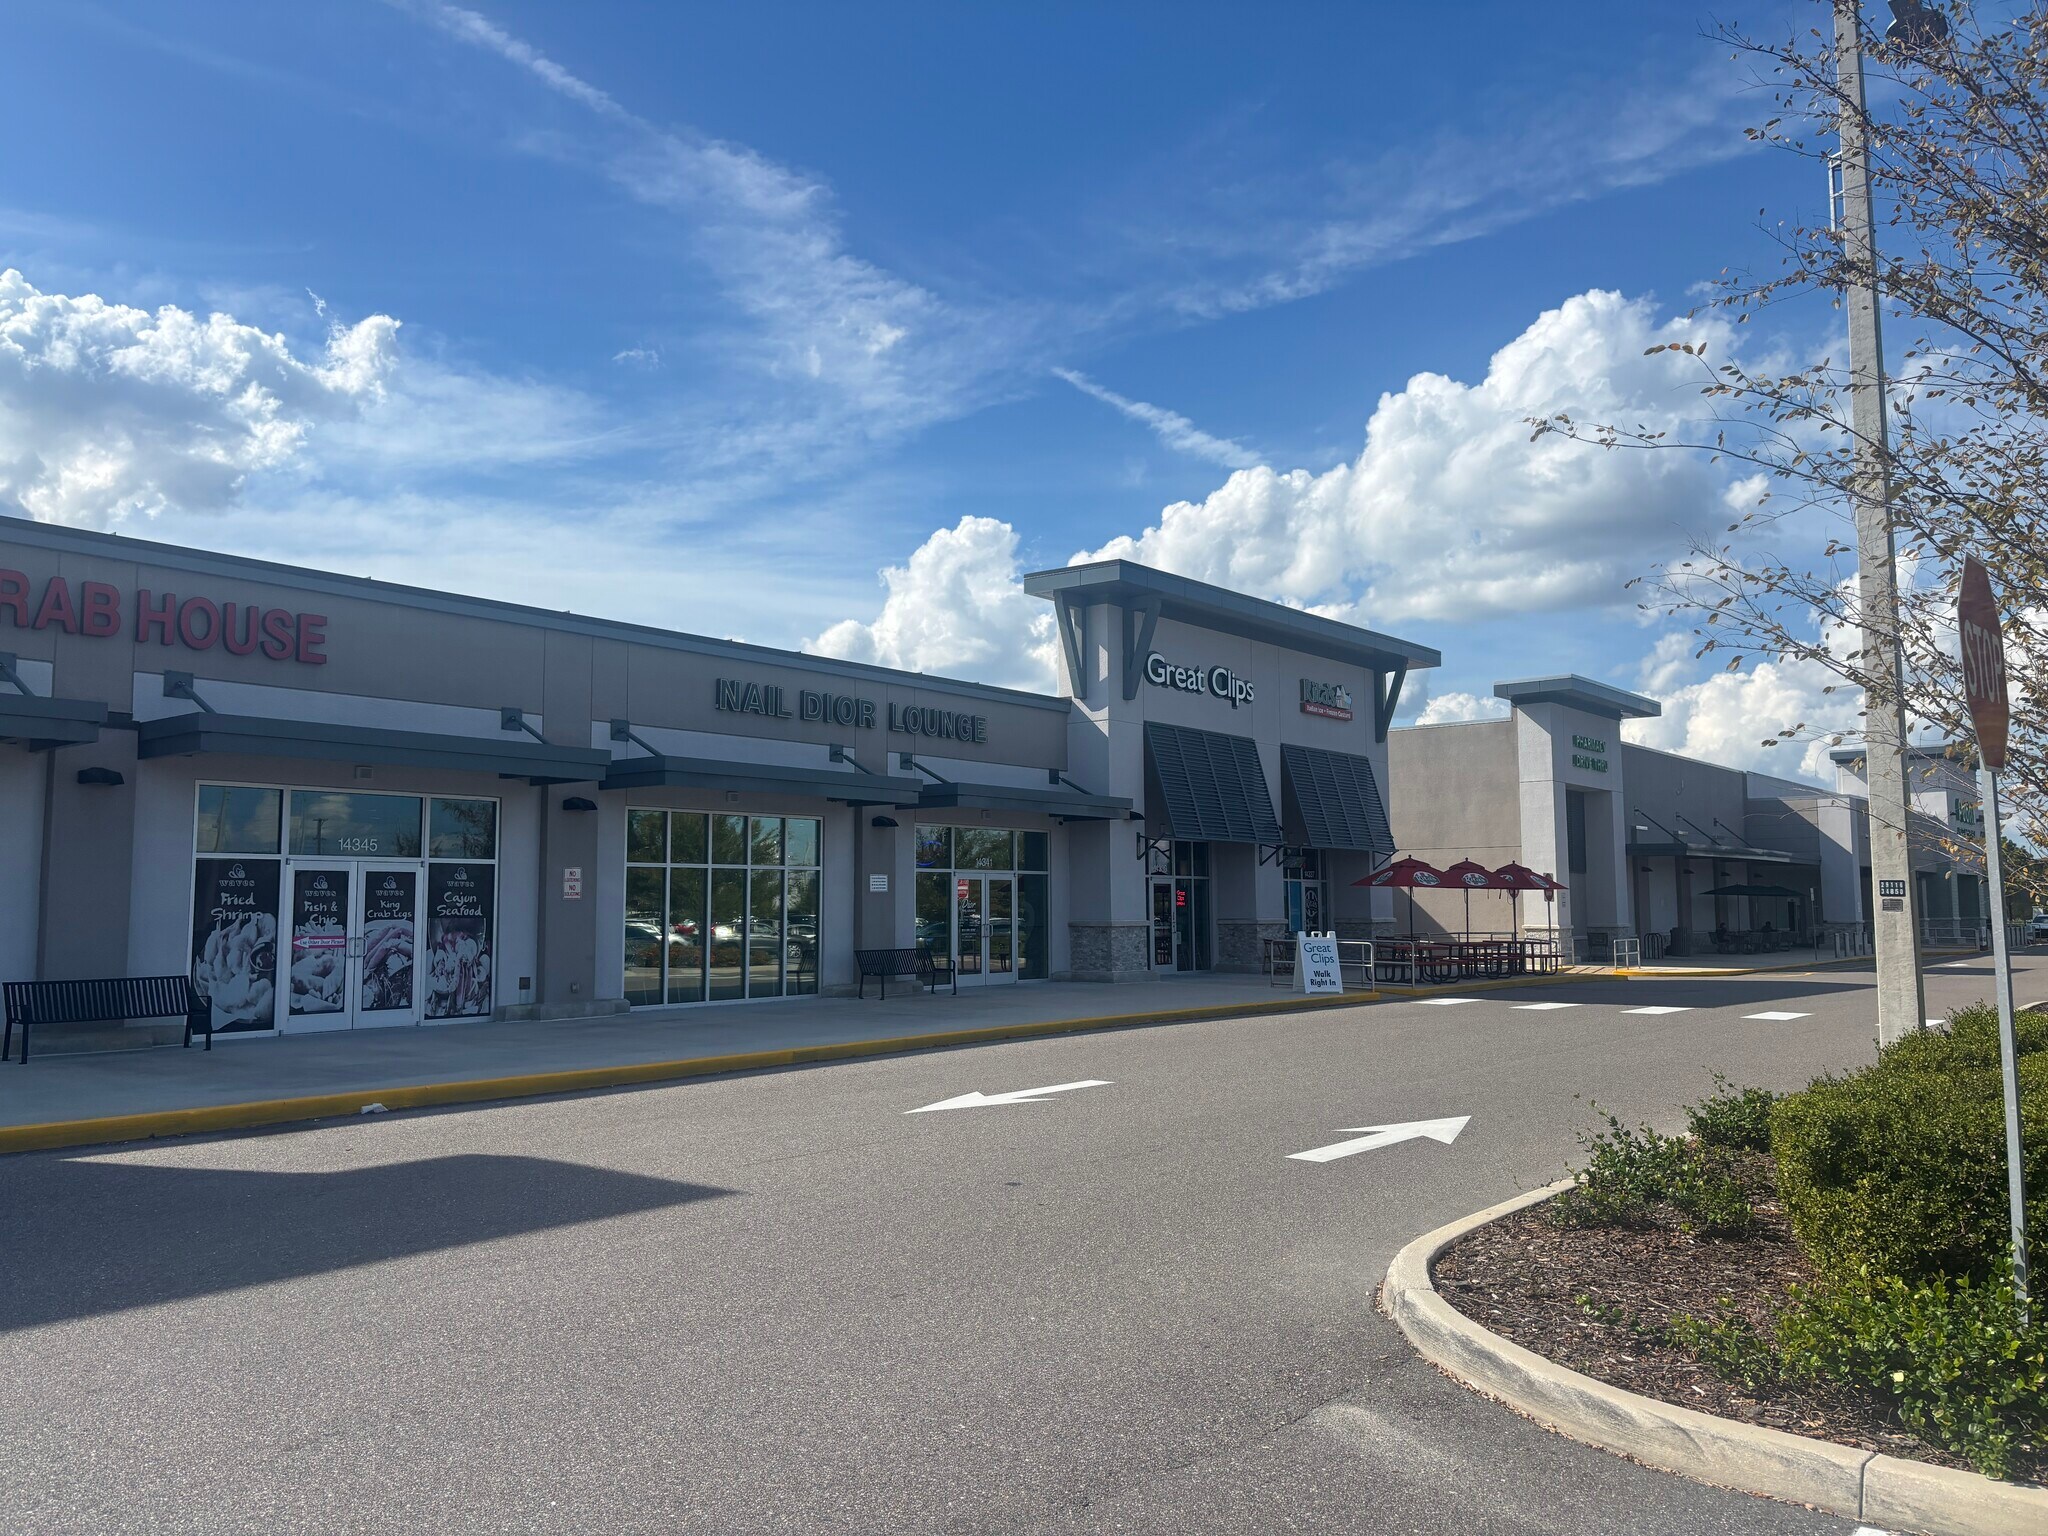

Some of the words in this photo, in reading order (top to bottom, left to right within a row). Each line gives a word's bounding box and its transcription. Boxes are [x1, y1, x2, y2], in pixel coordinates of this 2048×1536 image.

[135, 589, 327, 664] HOUSE
[1964, 619, 2002, 704] STOP
[1145, 653, 1205, 693] Great
[1210, 667, 1254, 707] Clips
[716, 678, 793, 718] NAIL
[800, 690, 876, 728] DIOR
[889, 702, 988, 743] LOUNGE
[338, 837, 378, 852] 14345
[569, 870, 577, 878] NO
[219, 879, 255, 887] waves
[446, 880, 475, 888] waves
[568, 884, 577, 892] NO
[220, 892, 256, 906] Fried
[375, 889, 405, 897] waves
[443, 892, 477, 907] Cajun
[304, 901, 327, 912] Fish
[330, 901, 338, 912] &
[380, 900, 401, 912] King
[436, 905, 483, 917] Seafood
[210, 908, 264, 923] Shrimp
[367, 910, 391, 918] Crab
[393, 910, 413, 920] Legs
[1303, 942, 1332, 953] Great
[1311, 953, 1335, 966] Clips
[1313, 970, 1331, 978] Walk
[1310, 979, 1328, 988] Right
[1329, 979, 1337, 987] In
